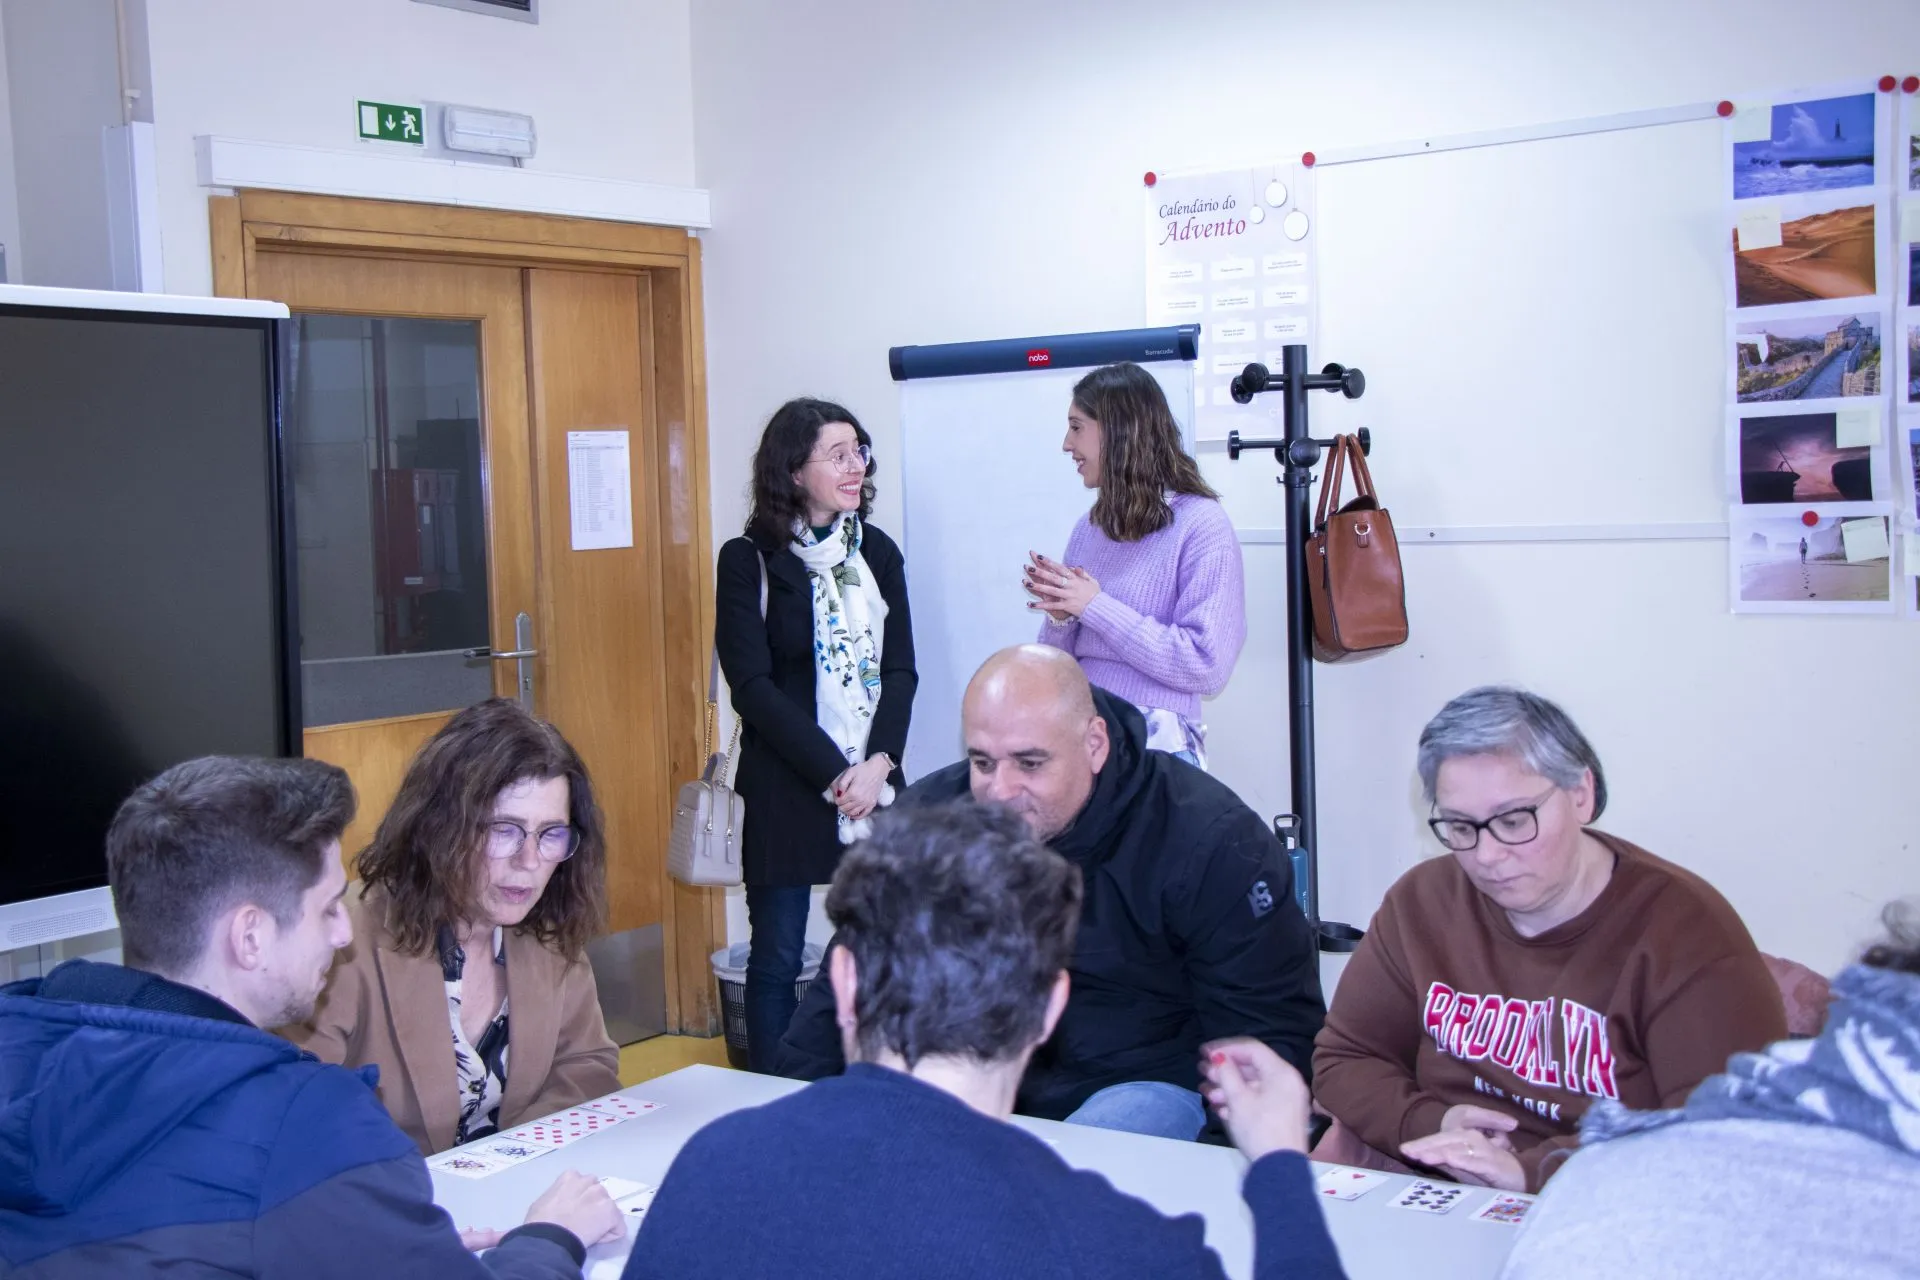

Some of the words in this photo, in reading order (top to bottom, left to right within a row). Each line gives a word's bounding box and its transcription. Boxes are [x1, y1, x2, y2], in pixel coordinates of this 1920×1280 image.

[1159, 198, 1219, 219] Calendário
[1222, 195, 1236, 210] do
[1159, 216, 1246, 246] Advento
[1028, 353, 1049, 362] nobo
[1423, 981, 1619, 1101] BROOKLYN
